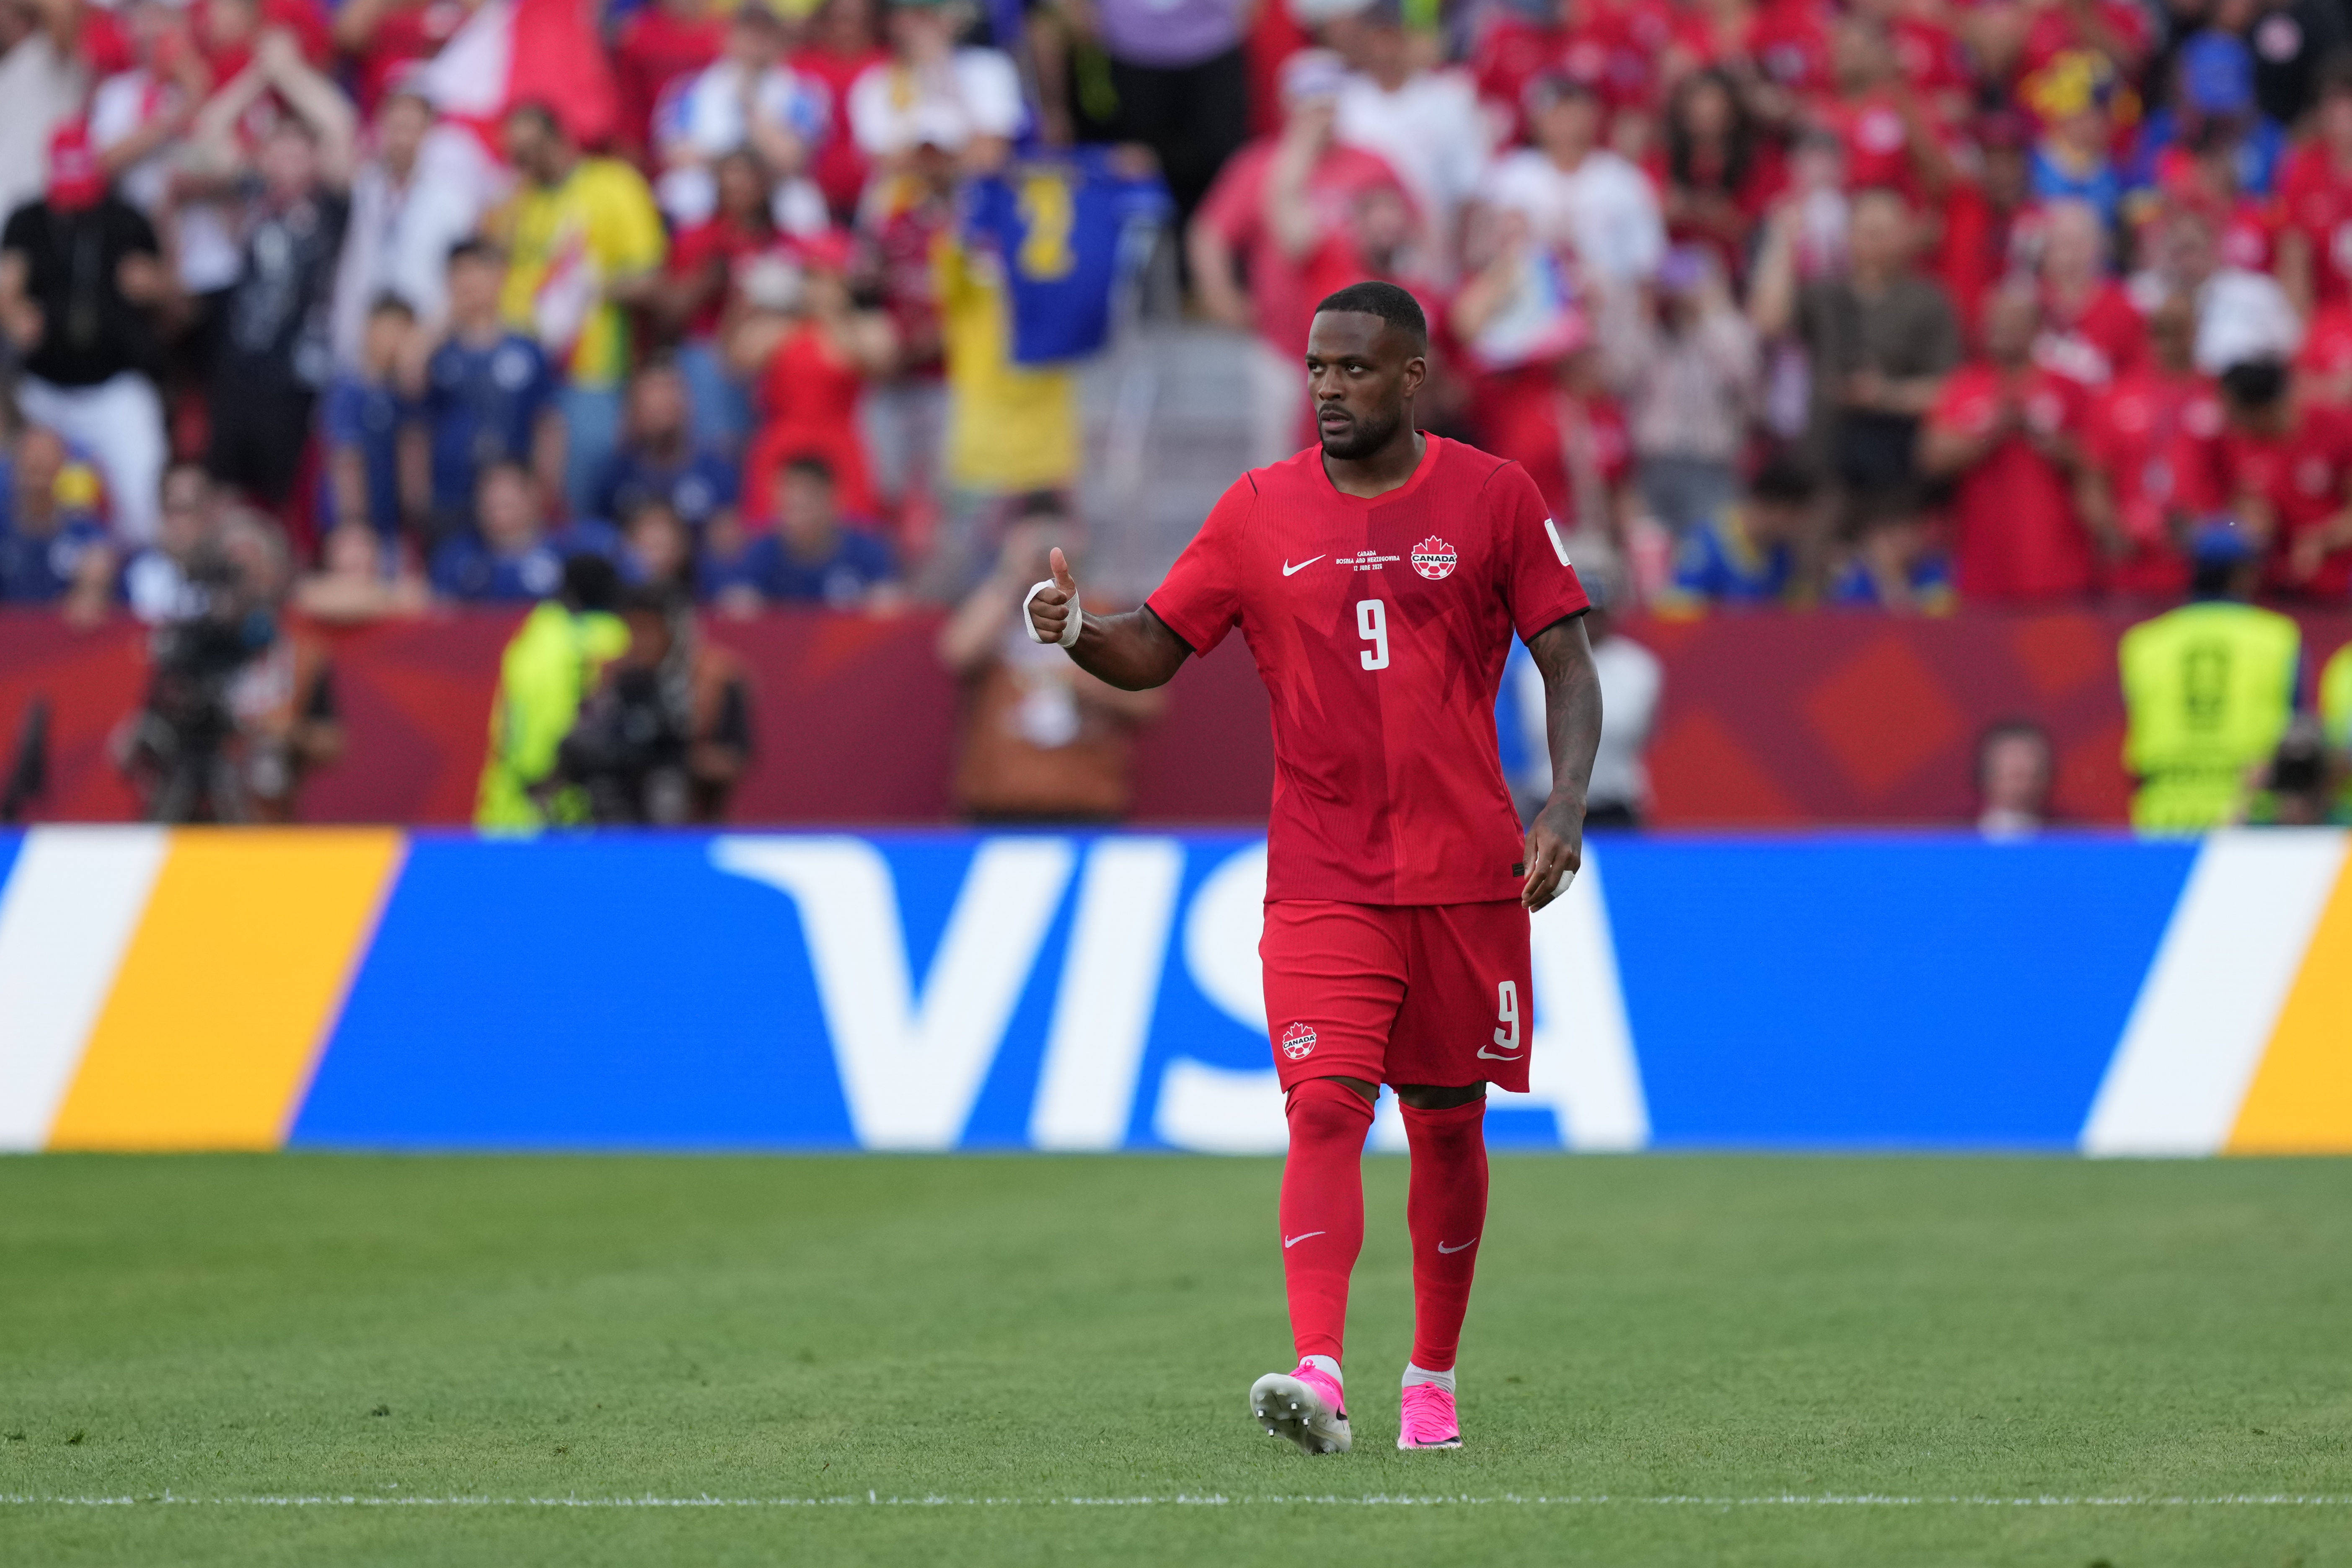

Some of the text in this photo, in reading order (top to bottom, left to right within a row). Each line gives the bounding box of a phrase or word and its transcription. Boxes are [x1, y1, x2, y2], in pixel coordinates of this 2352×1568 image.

[1356, 599, 1389, 670] 9
[1283, 1036, 1315, 1049] CANADA
[1493, 980, 1519, 1049] 9
